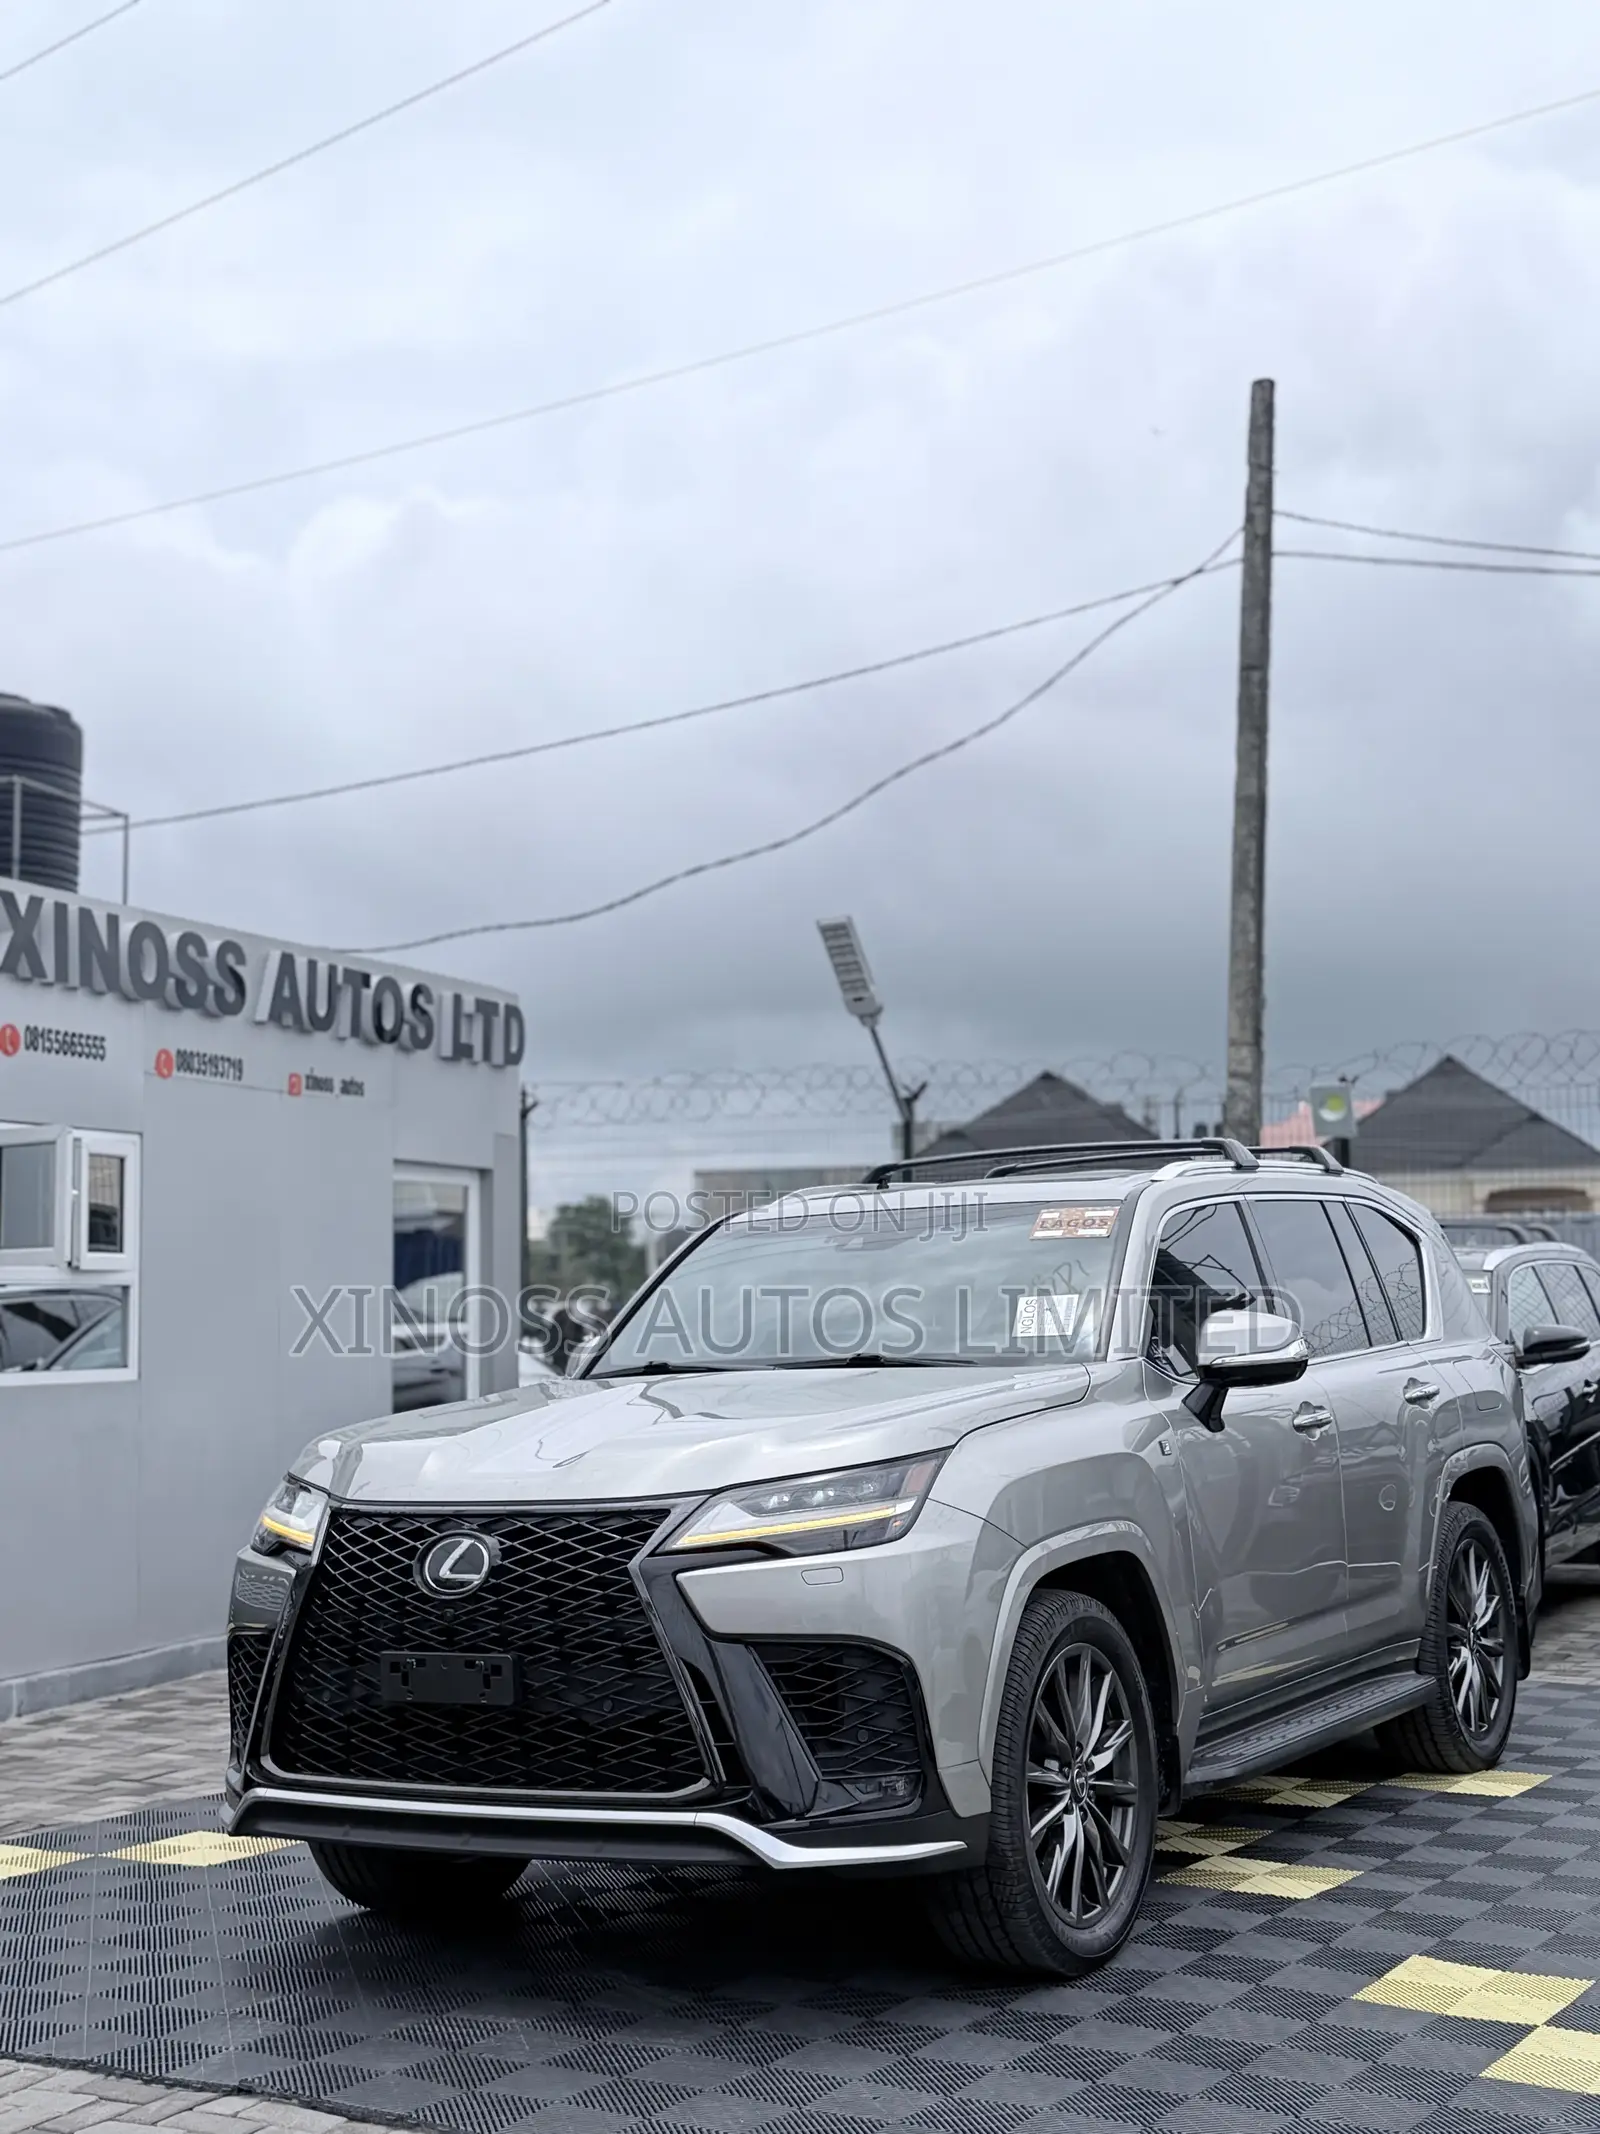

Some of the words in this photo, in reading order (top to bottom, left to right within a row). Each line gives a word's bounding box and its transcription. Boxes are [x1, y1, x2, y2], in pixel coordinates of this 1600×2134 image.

[0, 889, 248, 1017] XINOSS
[260, 951, 434, 1050] AUTOS
[447, 991, 525, 1066] LTD
[1039, 1217, 1109, 1230] LAGOS
[1019, 1298, 1038, 1335] NGLOS
